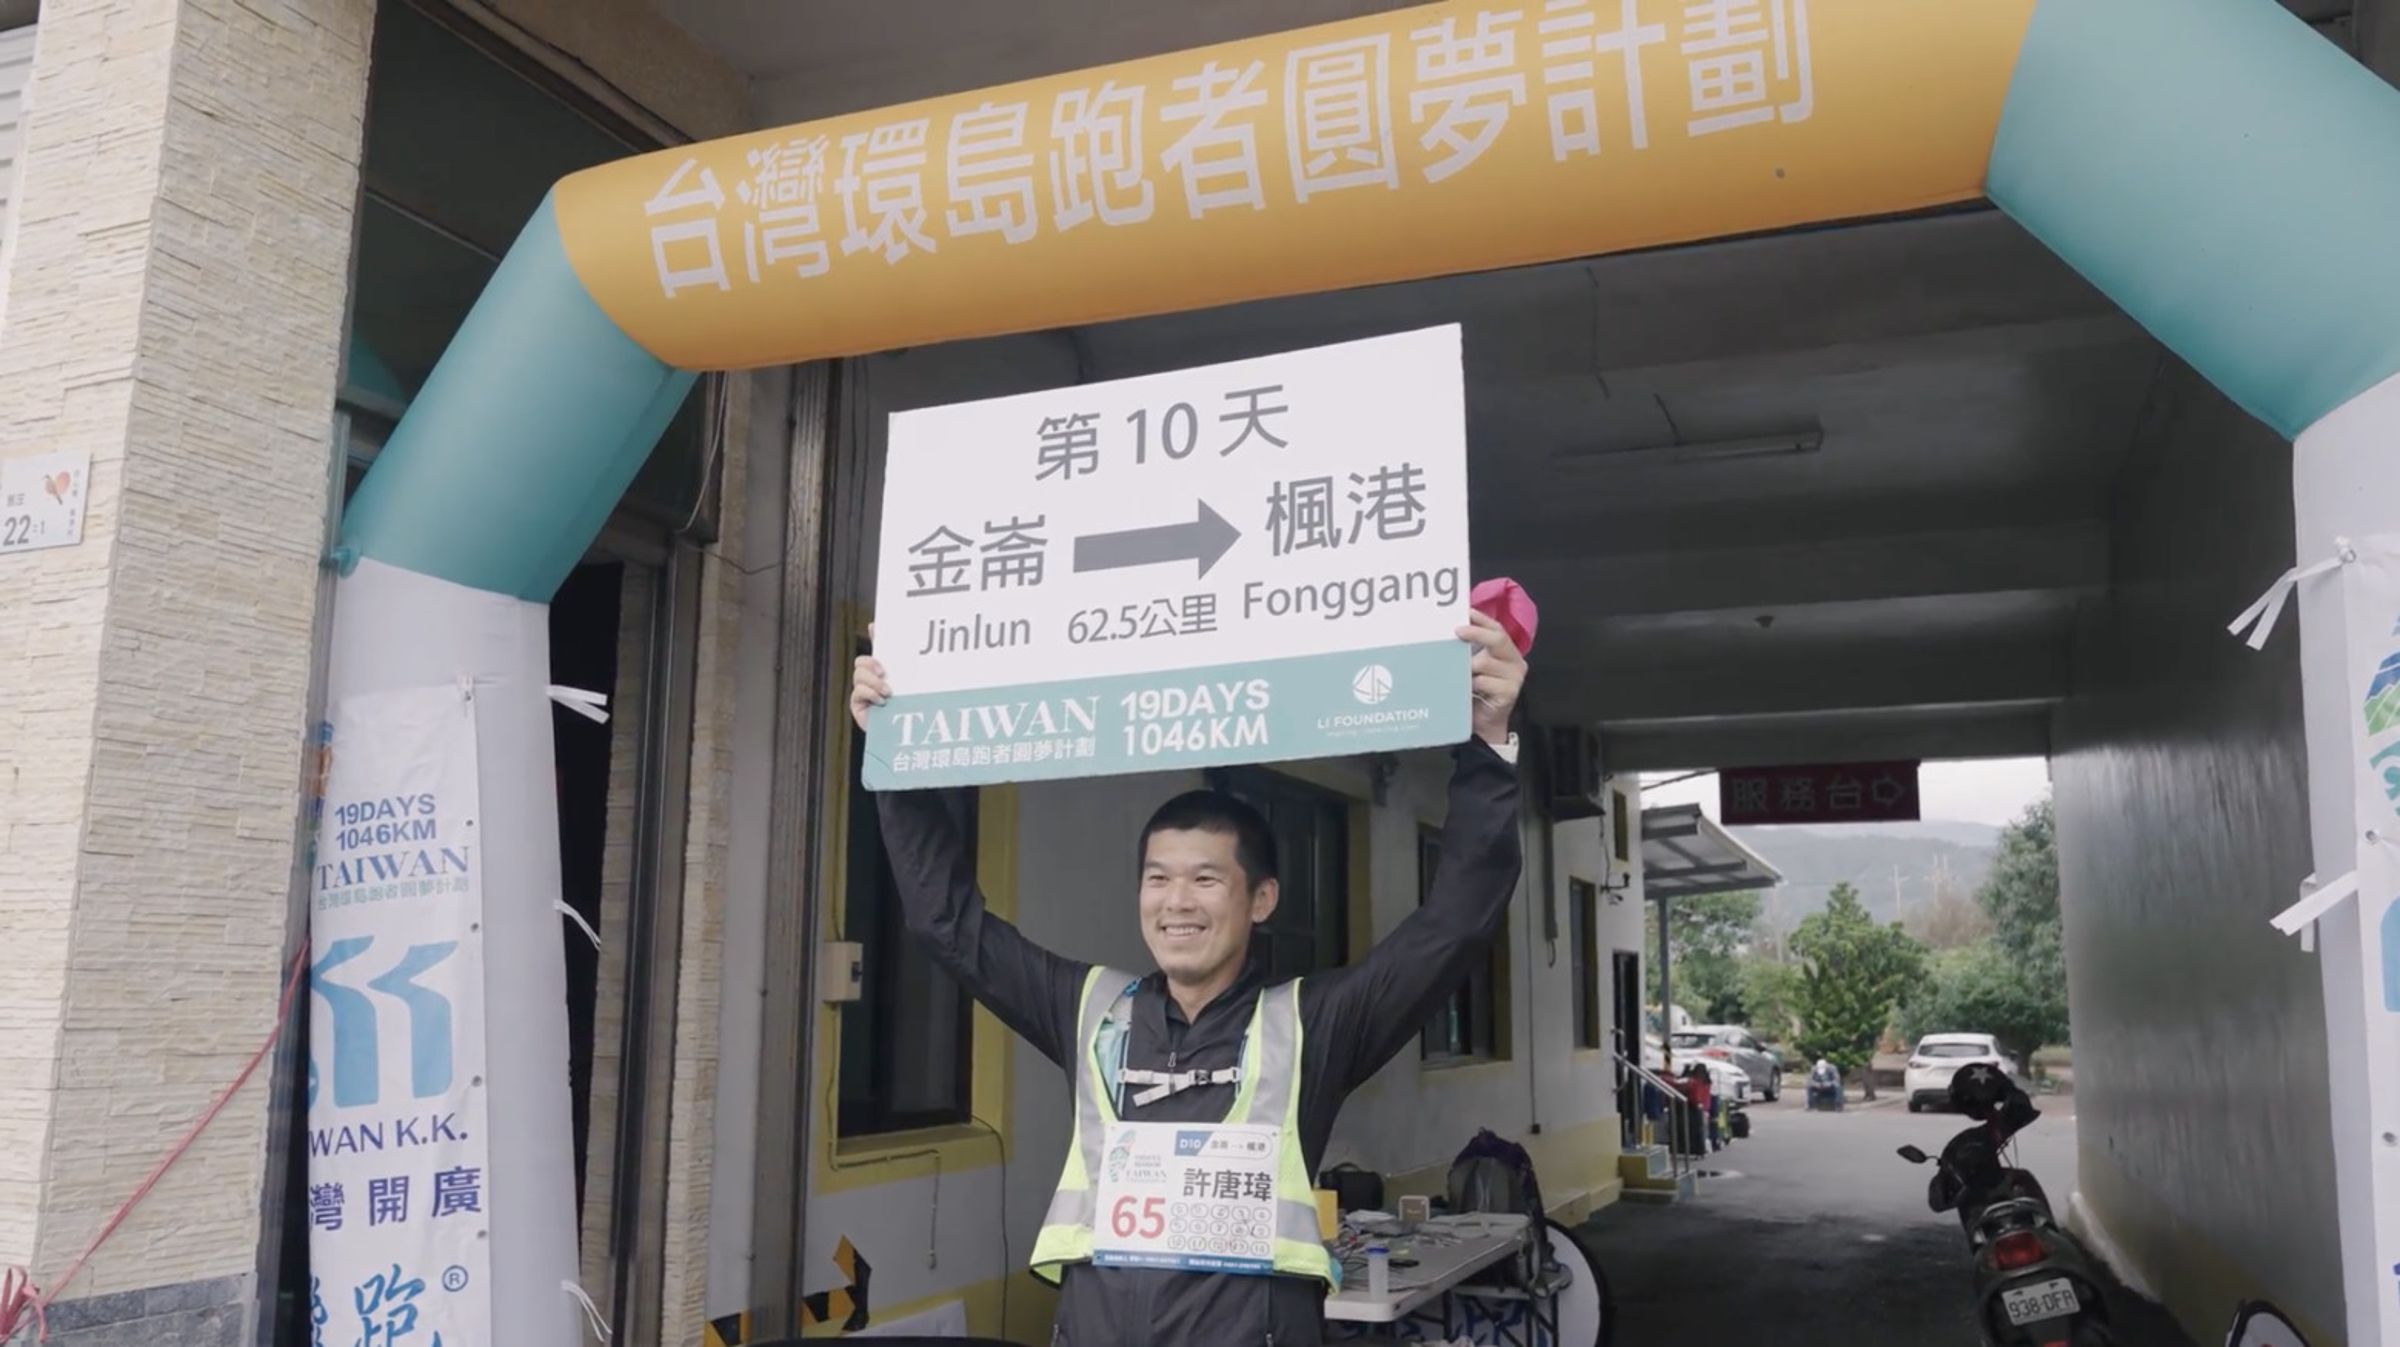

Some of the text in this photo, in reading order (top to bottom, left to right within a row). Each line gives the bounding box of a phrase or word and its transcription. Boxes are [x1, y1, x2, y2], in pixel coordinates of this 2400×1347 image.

[643, 0, 1815, 299] 台灣環島跑者圓夢計劃
[1035, 384, 1289, 481] 第 10 天
[1266, 462, 1427, 558] 楓港
[904, 513, 1048, 598] 金崙
[1243, 566, 1460, 624] Fonggang
[918, 612, 1031, 655] Jinlun
[1067, 593, 1218, 645] 62.5公里
[891, 696, 1100, 747] TAIWAN
[1121, 679, 1271, 722] 19DAYS
[1334, 707, 1429, 727] FOUNDATION
[892, 736, 1096, 773] 台灣環島跑者圓夢計劃
[1123, 714, 1269, 757] 1046KM
[334, 793, 436, 827] 19DAYS
[335, 818, 437, 851] 1046KM
[316, 846, 471, 891] TAIWAN
[395, 1112, 468, 1148] K.K.
[1179, 1138, 1201, 1150] D10
[1183, 1167, 1272, 1202] 許唐瑋
[1111, 1195, 1167, 1239] 65
